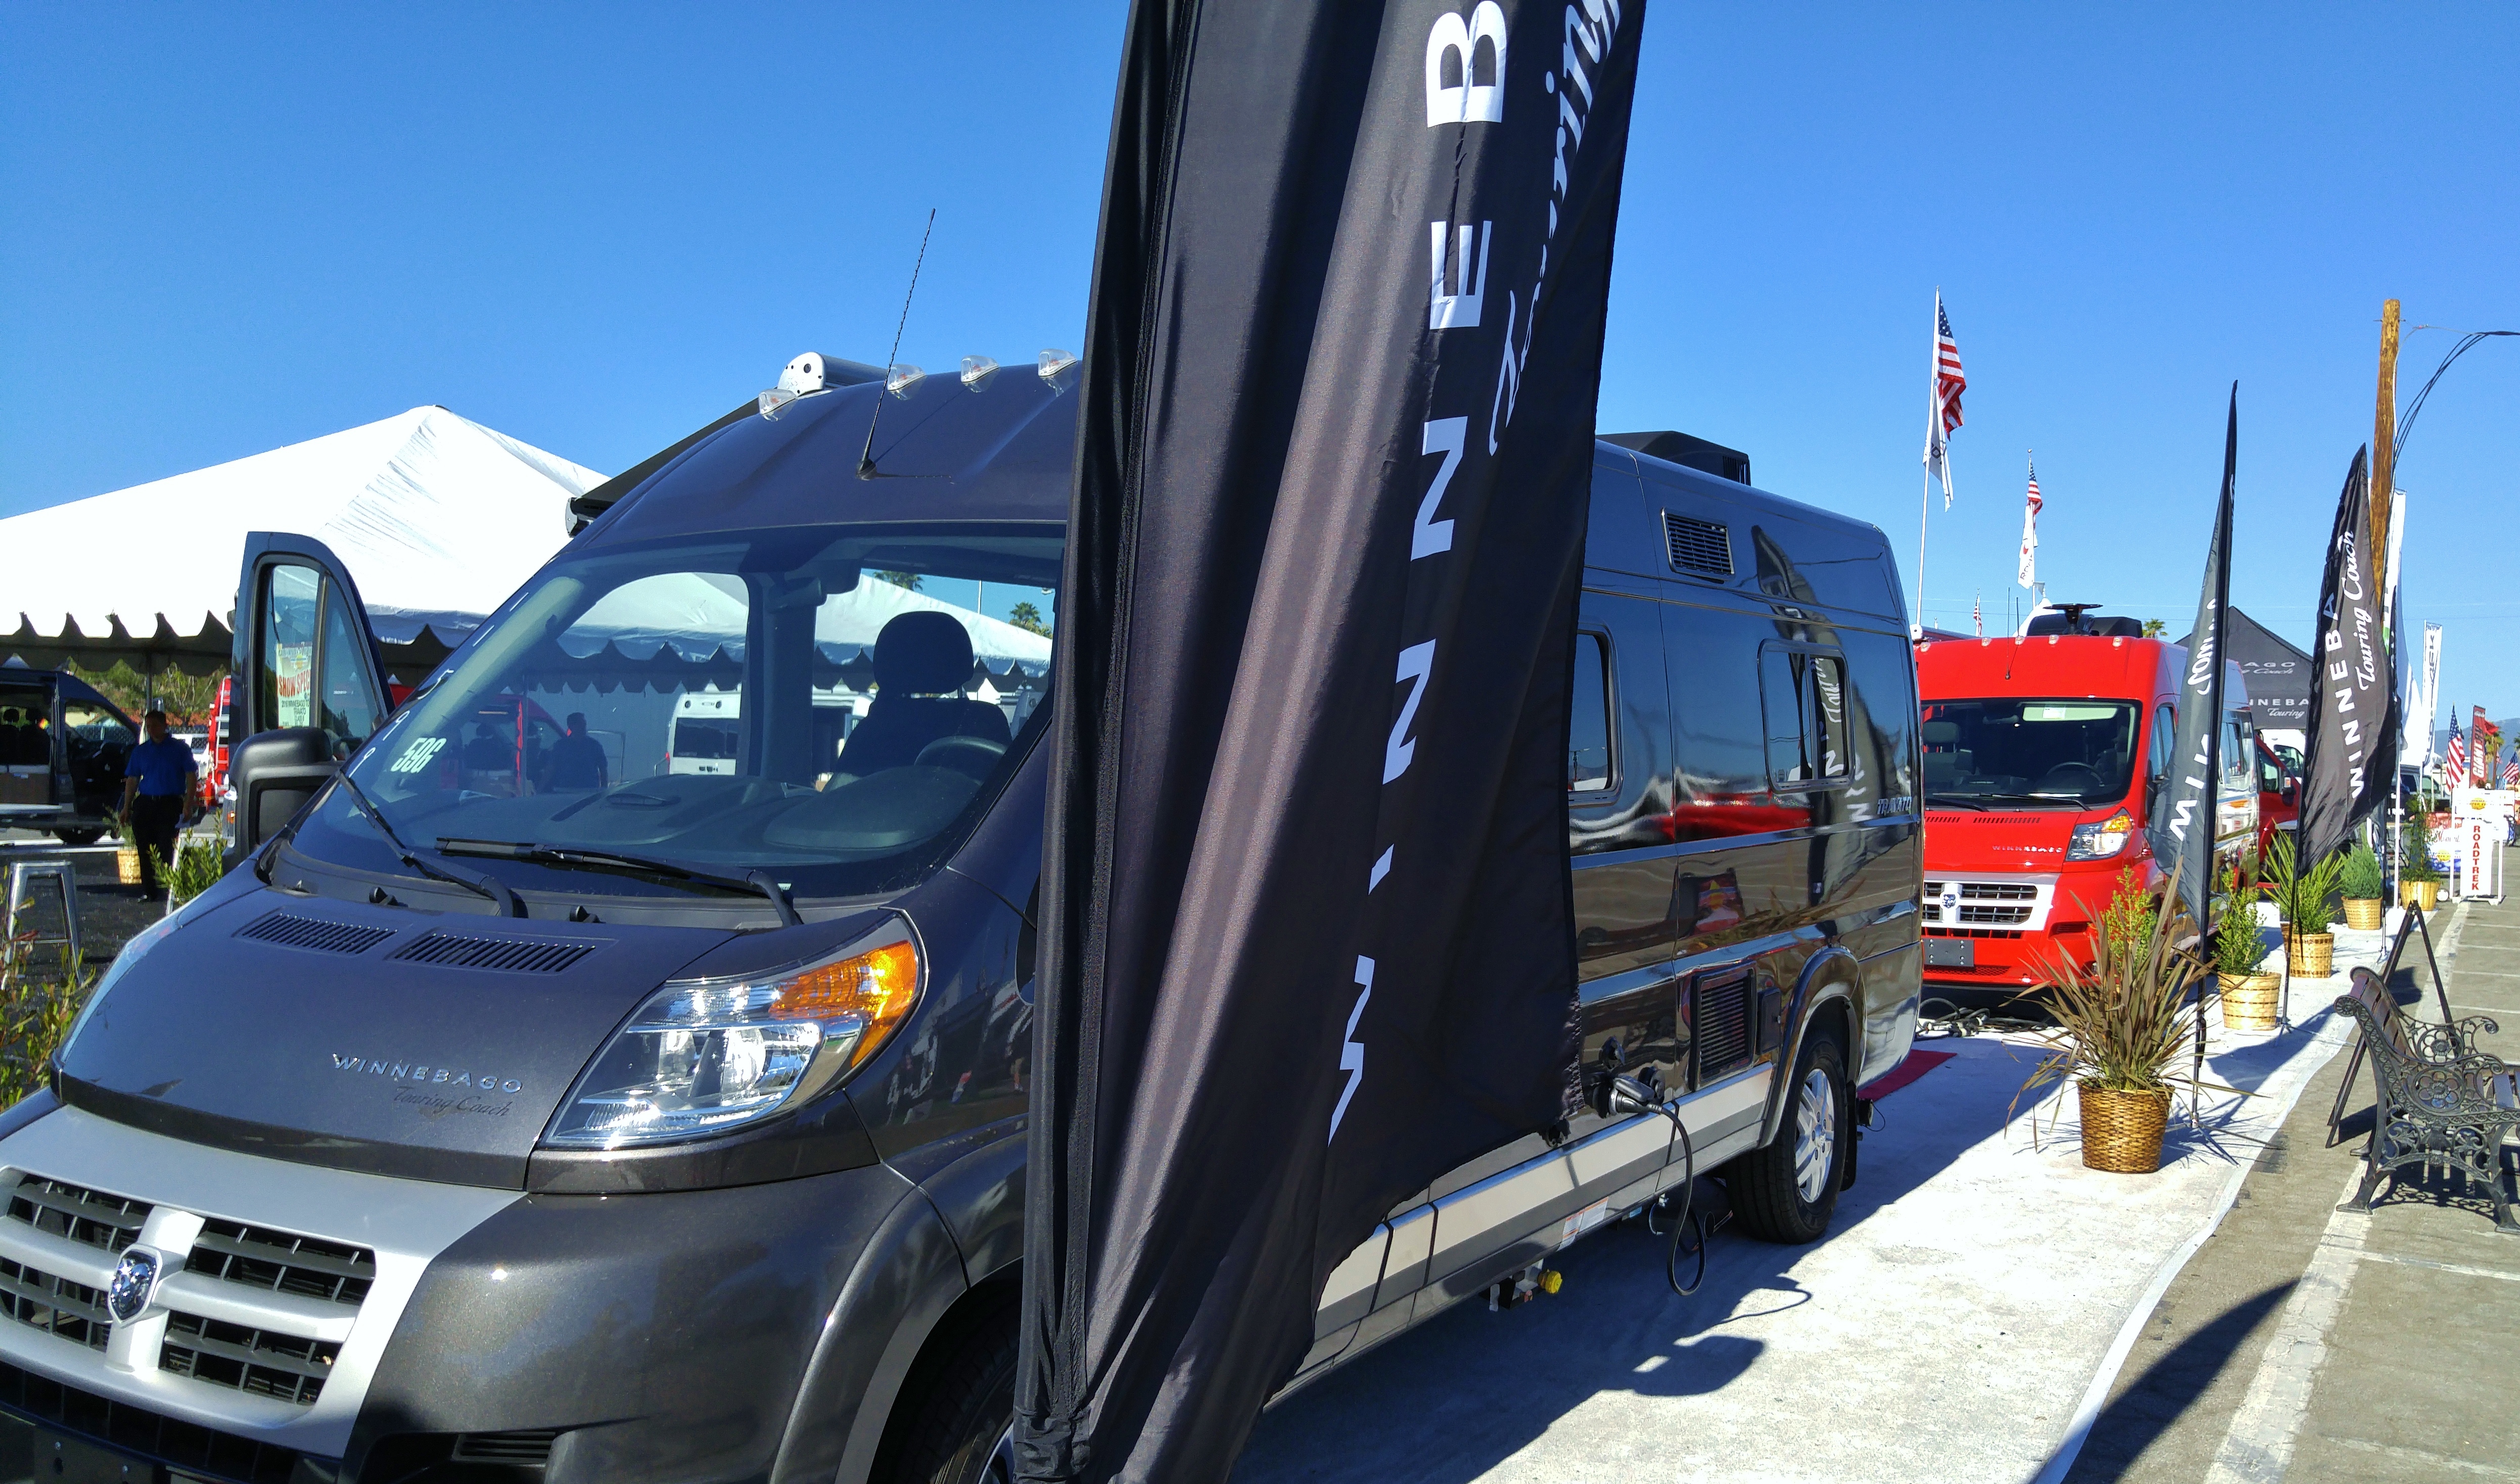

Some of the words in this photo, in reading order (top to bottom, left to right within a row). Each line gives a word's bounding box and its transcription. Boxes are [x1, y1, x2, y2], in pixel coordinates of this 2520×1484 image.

[2353, 608, 2376, 691] Touring
[279, 674, 296, 698] SHOW
[2267, 708, 2305, 719] Touring
[2472, 740, 2484, 778] GIANT
[2471, 825, 2481, 891] ROADTREK
[333, 1053, 523, 1093] WINNEBAGO
[394, 1086, 454, 1114] Touring
[456, 1096, 514, 1116] Coach
